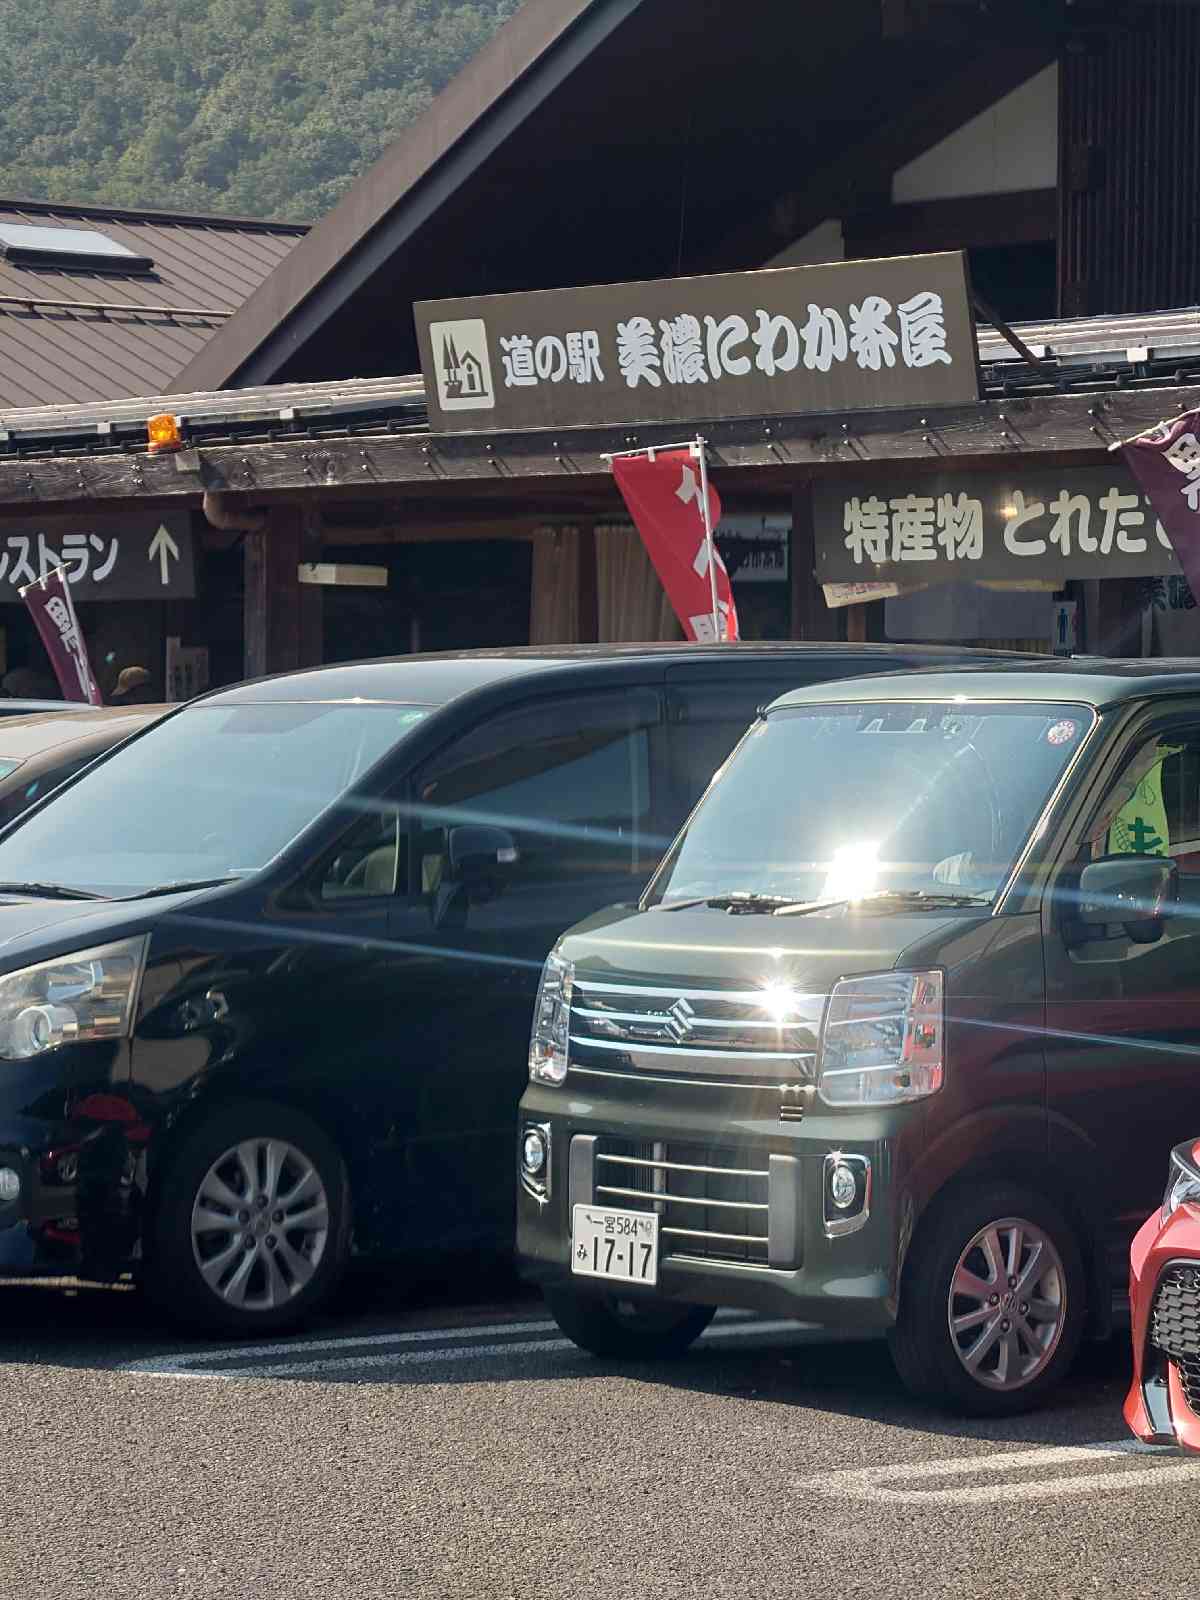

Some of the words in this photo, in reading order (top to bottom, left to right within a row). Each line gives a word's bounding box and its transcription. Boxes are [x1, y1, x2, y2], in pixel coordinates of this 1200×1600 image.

[499, 330, 605, 389] 道の駅
[615, 290, 953, 389] 美濃にわか茶屋
[843, 491, 984, 564] 特産物
[592, 1236, 653, 1279] 17-17
